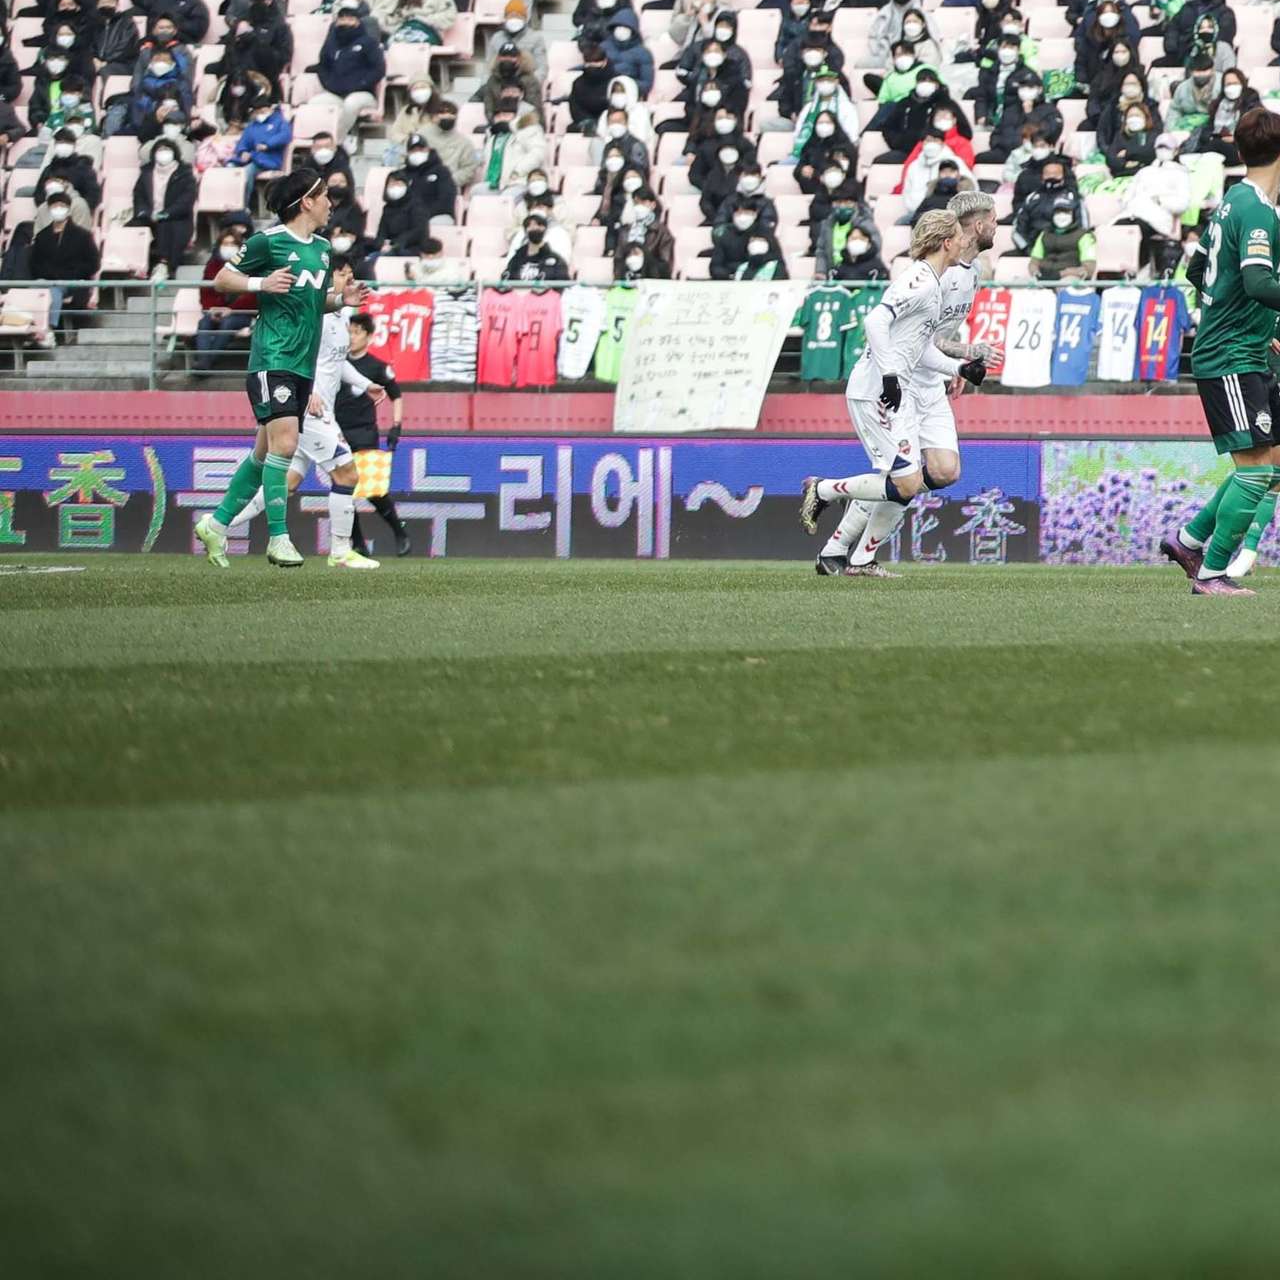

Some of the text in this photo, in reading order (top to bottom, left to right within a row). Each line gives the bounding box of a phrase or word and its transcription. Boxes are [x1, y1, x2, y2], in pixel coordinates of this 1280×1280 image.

[401, 314, 424, 353] 14
[566, 318, 583, 344] 5
[612, 316, 627, 343] 5
[816, 311, 833, 341] 8
[973, 312, 1007, 345] 25
[1013, 318, 1042, 351] 26
[1058, 313, 1082, 350] 14
[1146, 315, 1168, 351] 14
